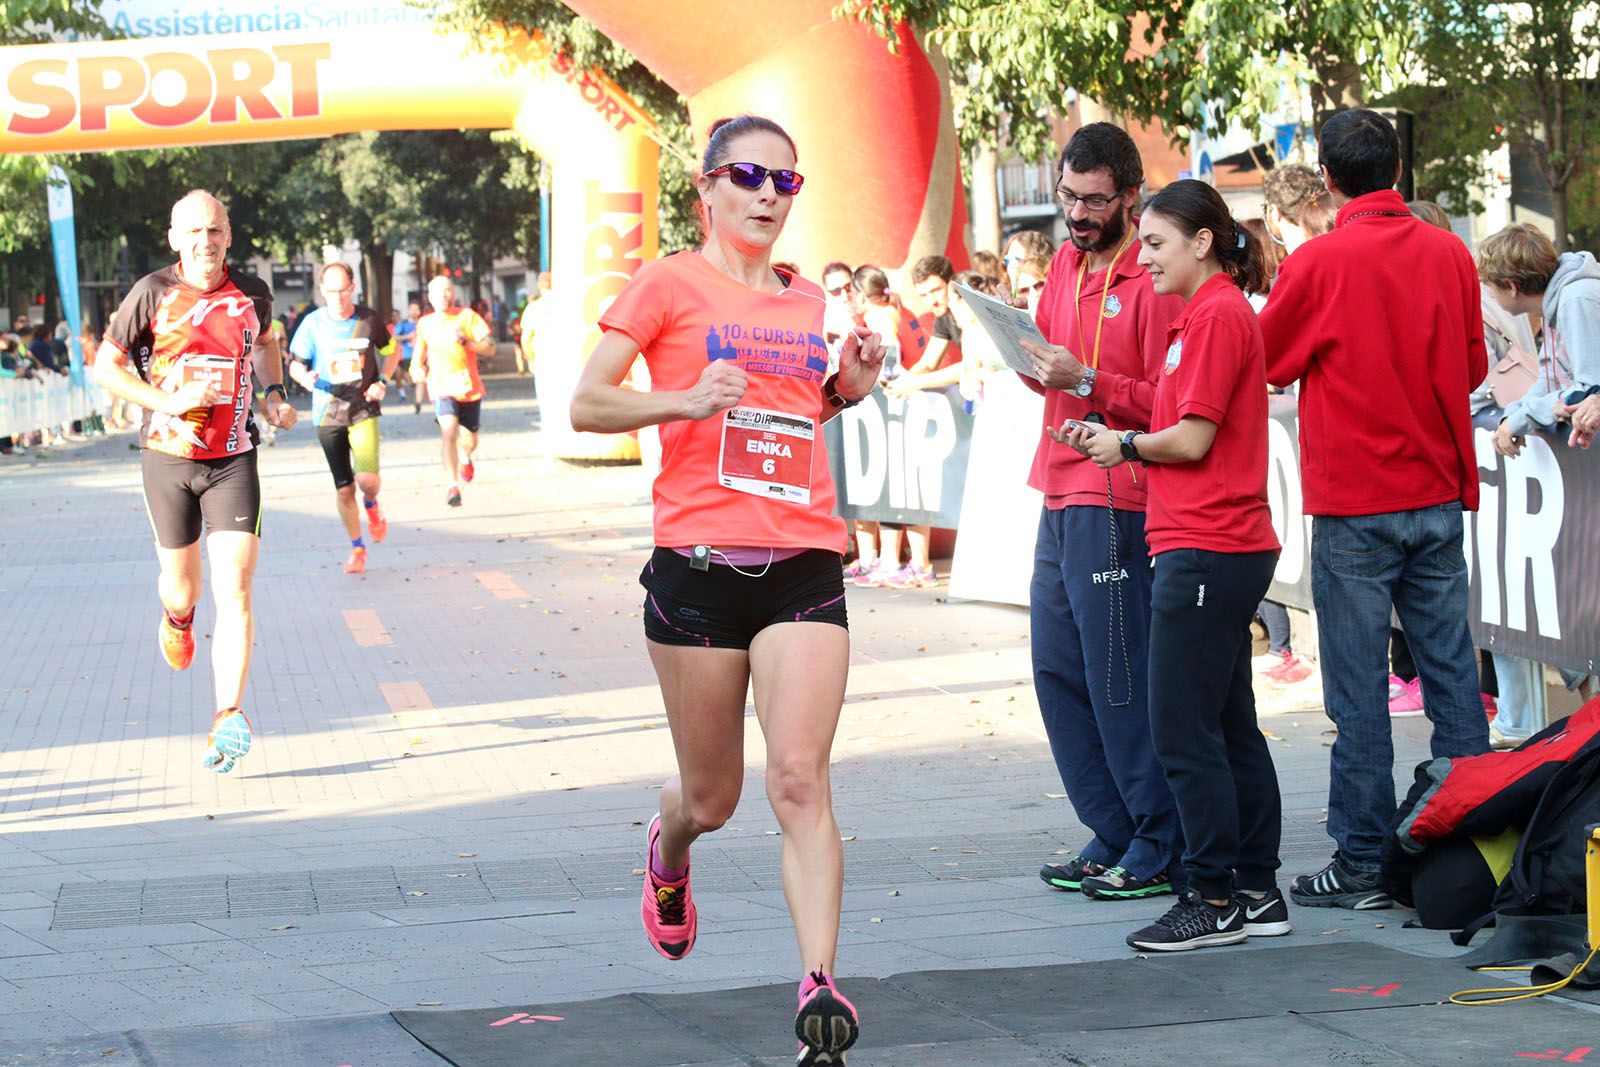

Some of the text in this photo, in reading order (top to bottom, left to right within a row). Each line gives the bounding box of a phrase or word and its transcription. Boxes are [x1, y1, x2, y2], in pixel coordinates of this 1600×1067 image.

[7, 42, 332, 135] SPORT
[752, 327, 805, 347] CURSA
[755, 412, 772, 425] DiR
[746, 439, 792, 458] ENKA
[841, 389, 957, 512] DiR
[762, 458, 775, 475] 6
[1092, 568, 1129, 584] RFEA
